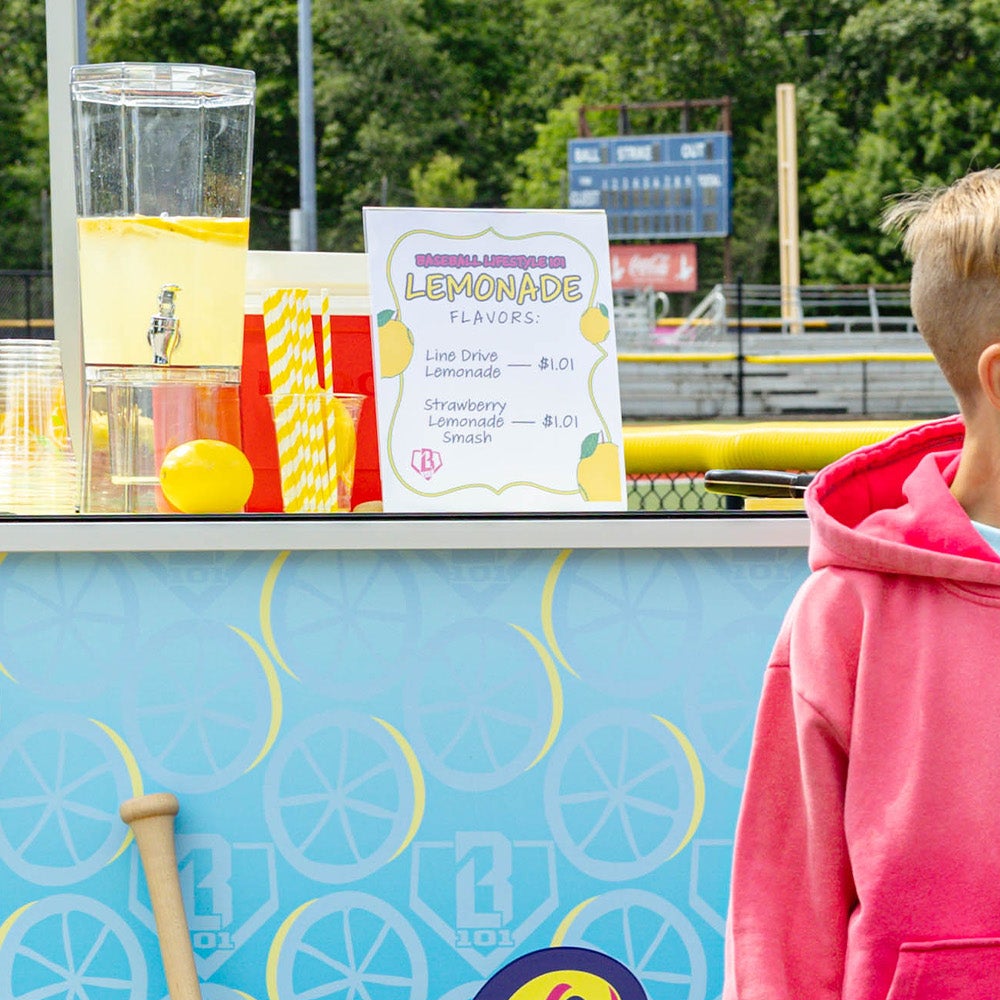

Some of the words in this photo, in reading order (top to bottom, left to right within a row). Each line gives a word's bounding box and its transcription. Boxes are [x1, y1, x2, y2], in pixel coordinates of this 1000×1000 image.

[414, 253, 480, 268] BASEBALL
[483, 255, 546, 270] LIFESTYLE
[549, 256, 567, 269] 101
[404, 271, 583, 306] LEMONADE
[449, 310, 541, 326] FLAVORS:
[426, 349, 456, 362] Line
[461, 349, 499, 362] Drive
[538, 356, 575, 371] $1.01
[425, 365, 502, 379] Lemonade
[424, 398, 508, 415] Strawberry
[428, 415, 505, 428] Lemonade
[542, 414, 579, 429] $1.01
[442, 431, 493, 444] Smash
[192, 931, 235, 949] 01
[455, 929, 515, 947] 101
